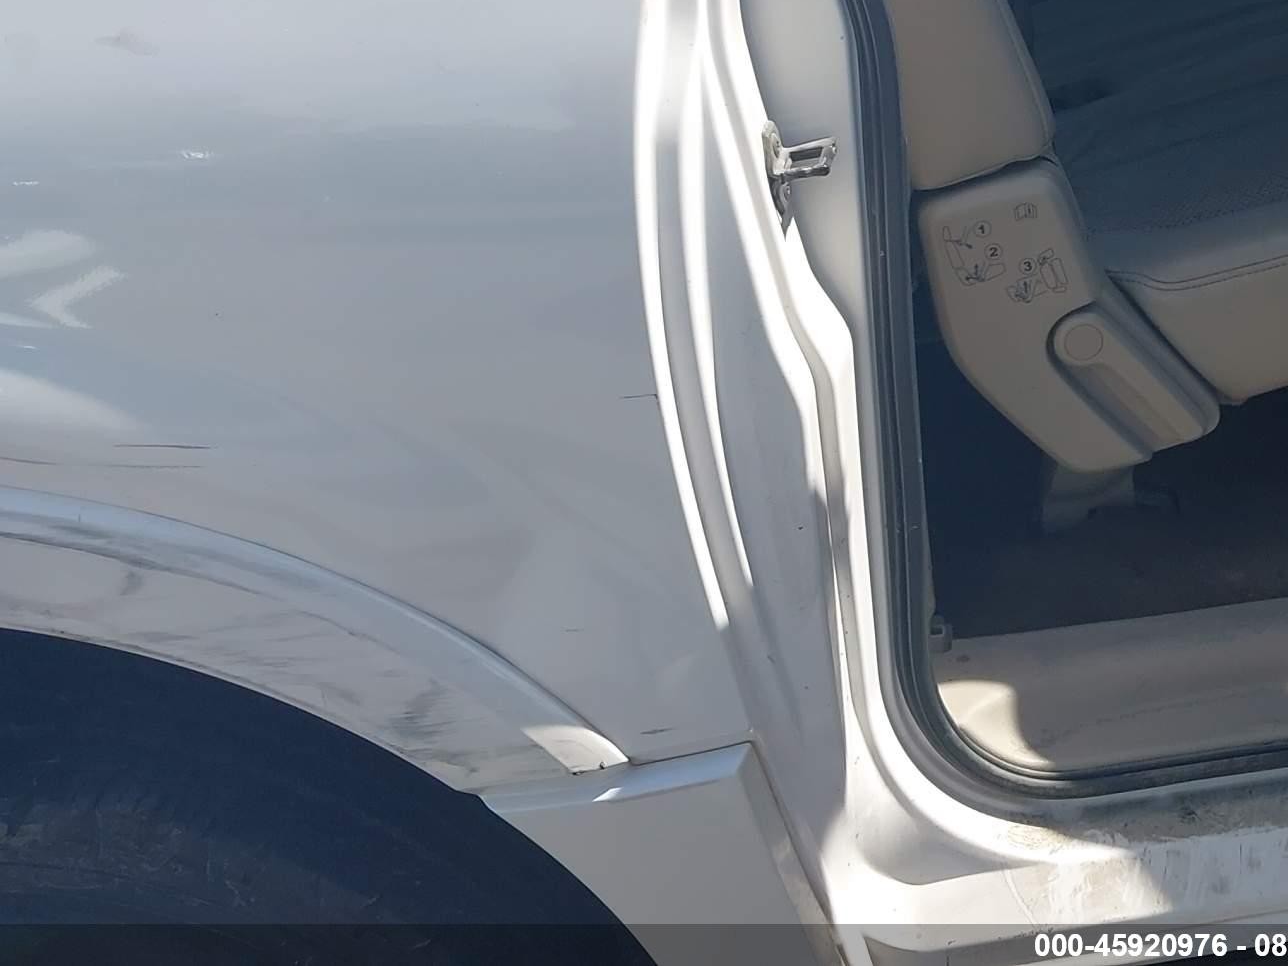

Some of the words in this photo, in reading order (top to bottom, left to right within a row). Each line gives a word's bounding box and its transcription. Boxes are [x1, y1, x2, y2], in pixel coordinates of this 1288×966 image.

[977, 224, 985, 235] 1
[989, 246, 999, 258] 2
[1023, 260, 1033, 272] 3
